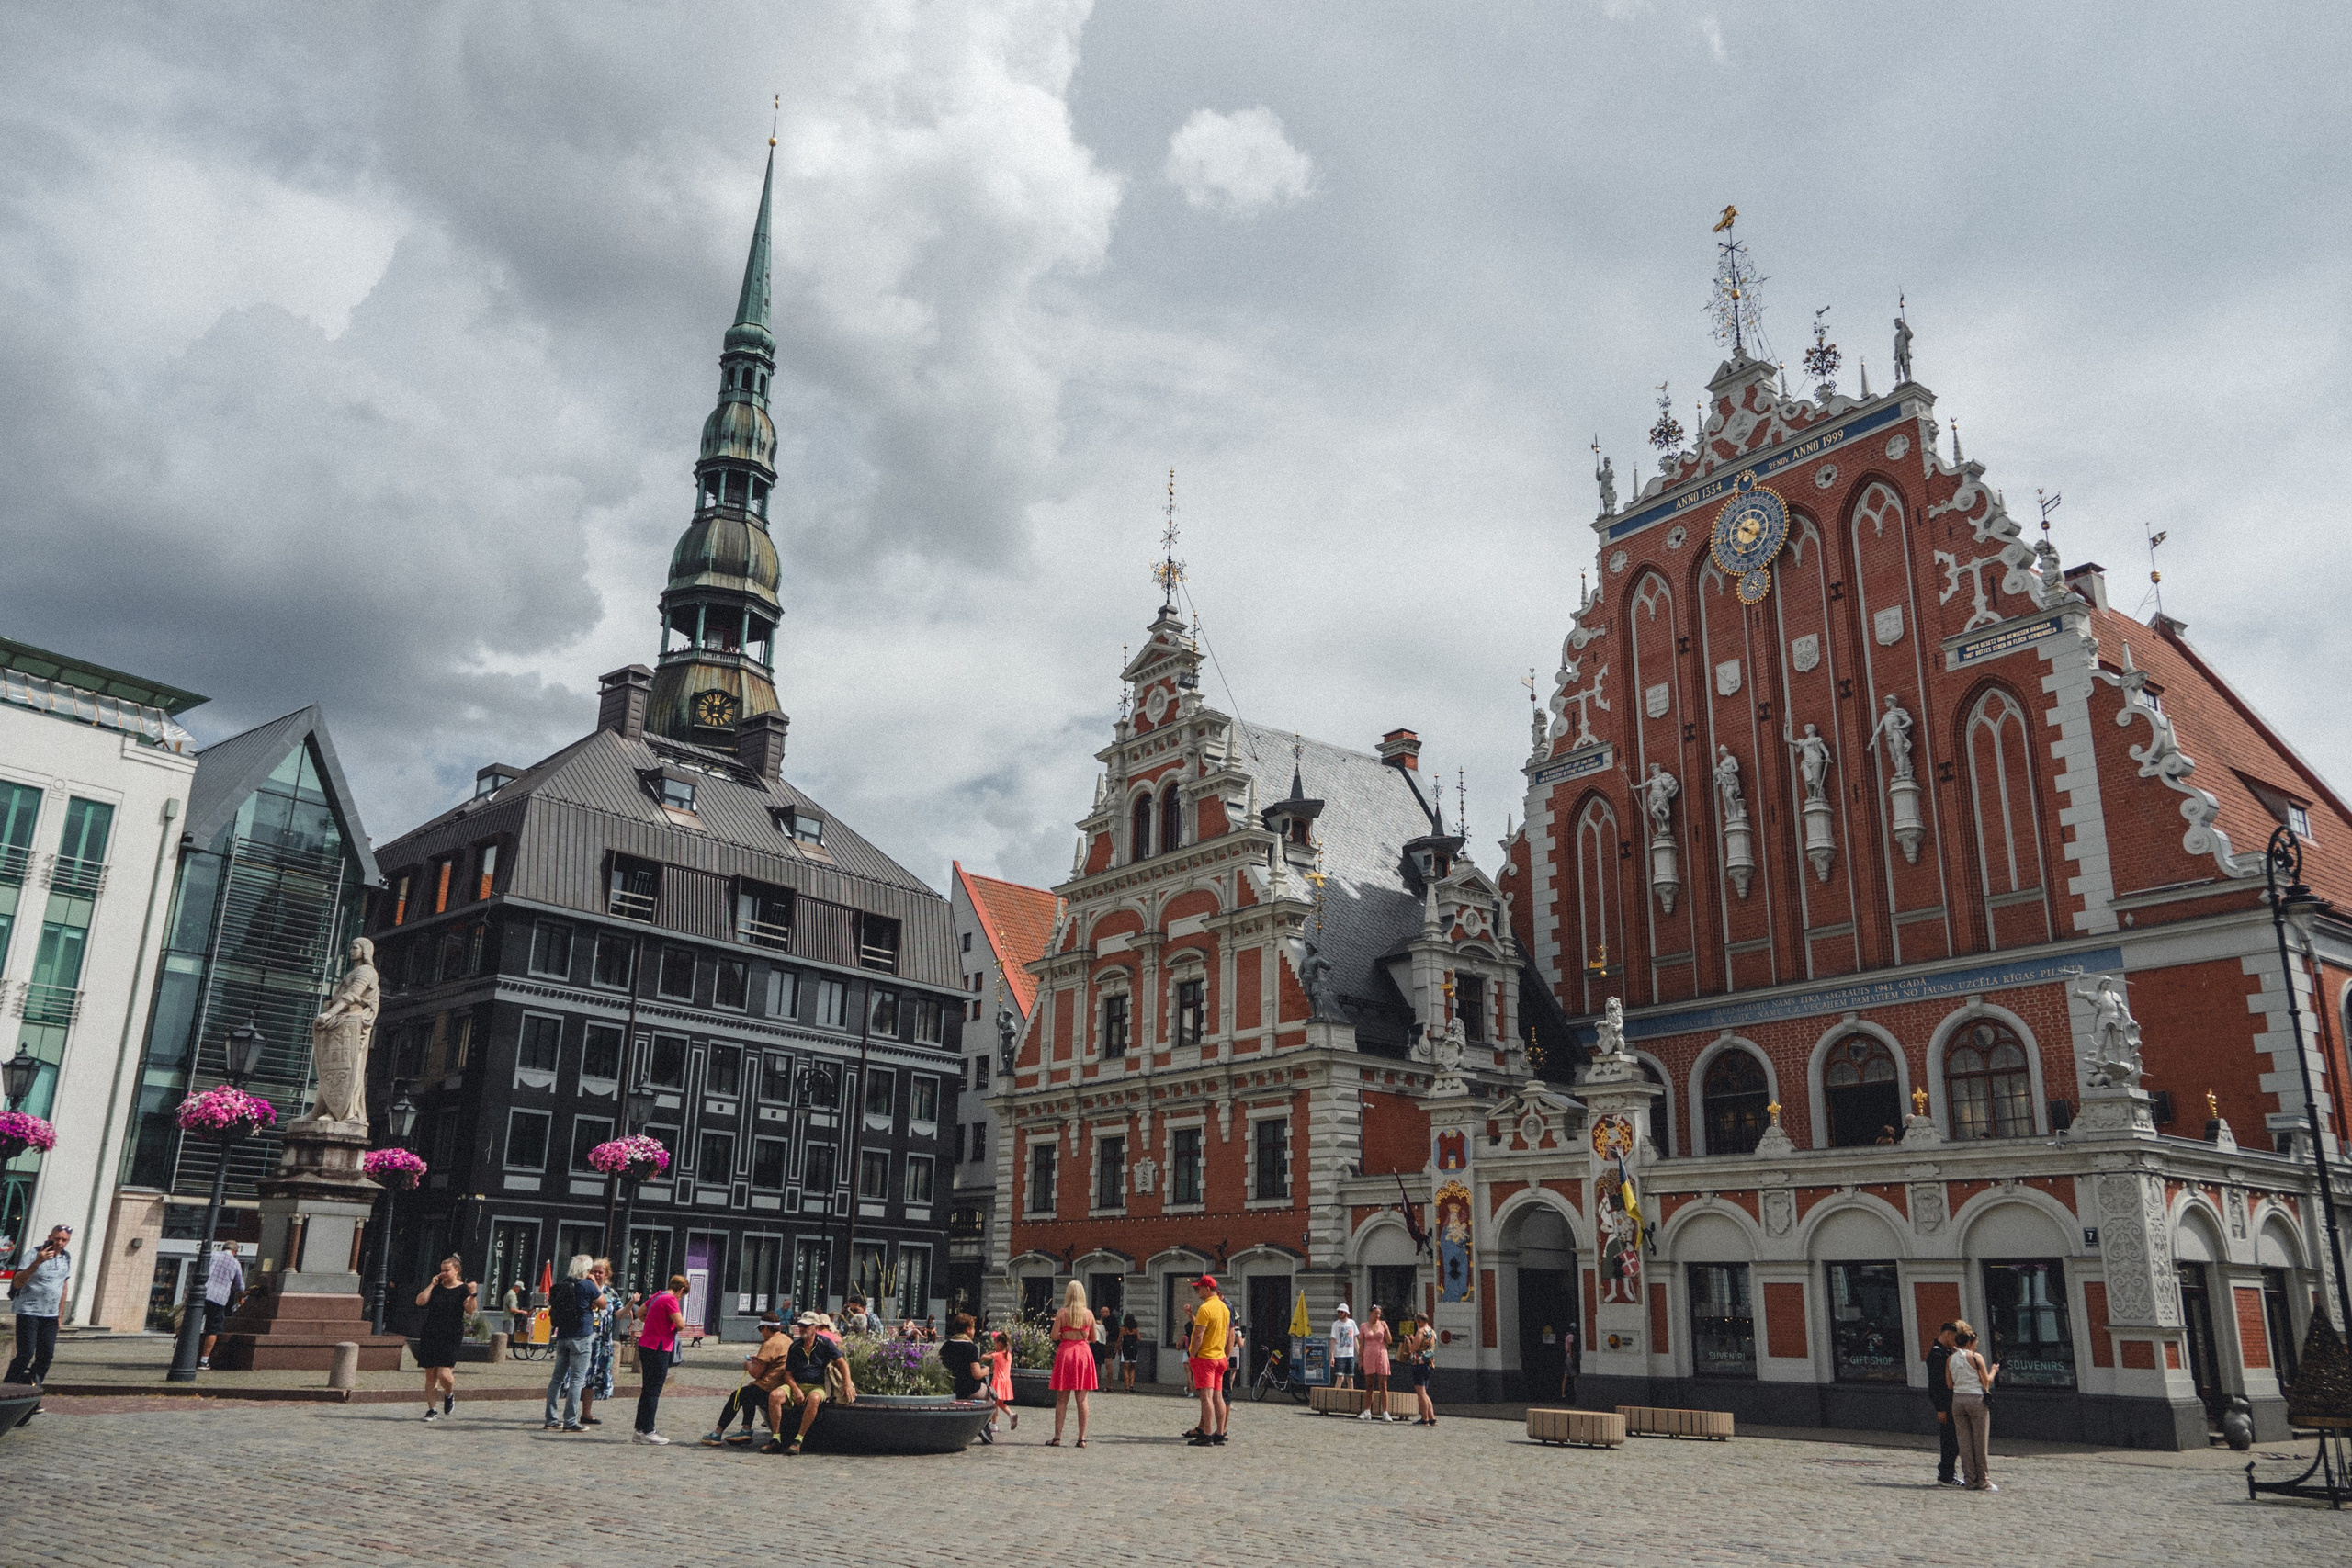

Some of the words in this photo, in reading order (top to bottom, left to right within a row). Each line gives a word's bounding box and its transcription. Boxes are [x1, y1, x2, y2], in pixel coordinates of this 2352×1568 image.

[1792, 441, 1819, 460] ANNO
[1822, 429, 1844, 448] 1999
[1675, 488, 1700, 511] ANNO
[1702, 481, 1723, 499] 1334
[1757, 1008, 1783, 1019] NAMU
[1787, 1005, 1801, 1013] UZ
[1804, 998, 1848, 1011] VECAJIEM
[1851, 990, 1899, 1005] PAMATIEM
[1903, 987, 1918, 998] NO
[1923, 982, 1954, 996] JAUNA
[1958, 976, 1999, 989] UZCĒLA
[1771, 998, 1795, 1008] NAMS
[1799, 994, 1820, 1004] TIKA
[1825, 987, 1870, 999] SAGRAUTS
[496, 1230, 504, 1258] FOR
[2087, 1232, 2094, 1240] 7
[631, 1238, 639, 1264] FOR
[490, 1268, 500, 1305] SALE
[794, 1280, 802, 1313] SALE
[1849, 1355, 1868, 1366] GIFT
[1870, 1356, 1894, 1367] SHOP
[2007, 1359, 2065, 1372] SOUVENIRS
